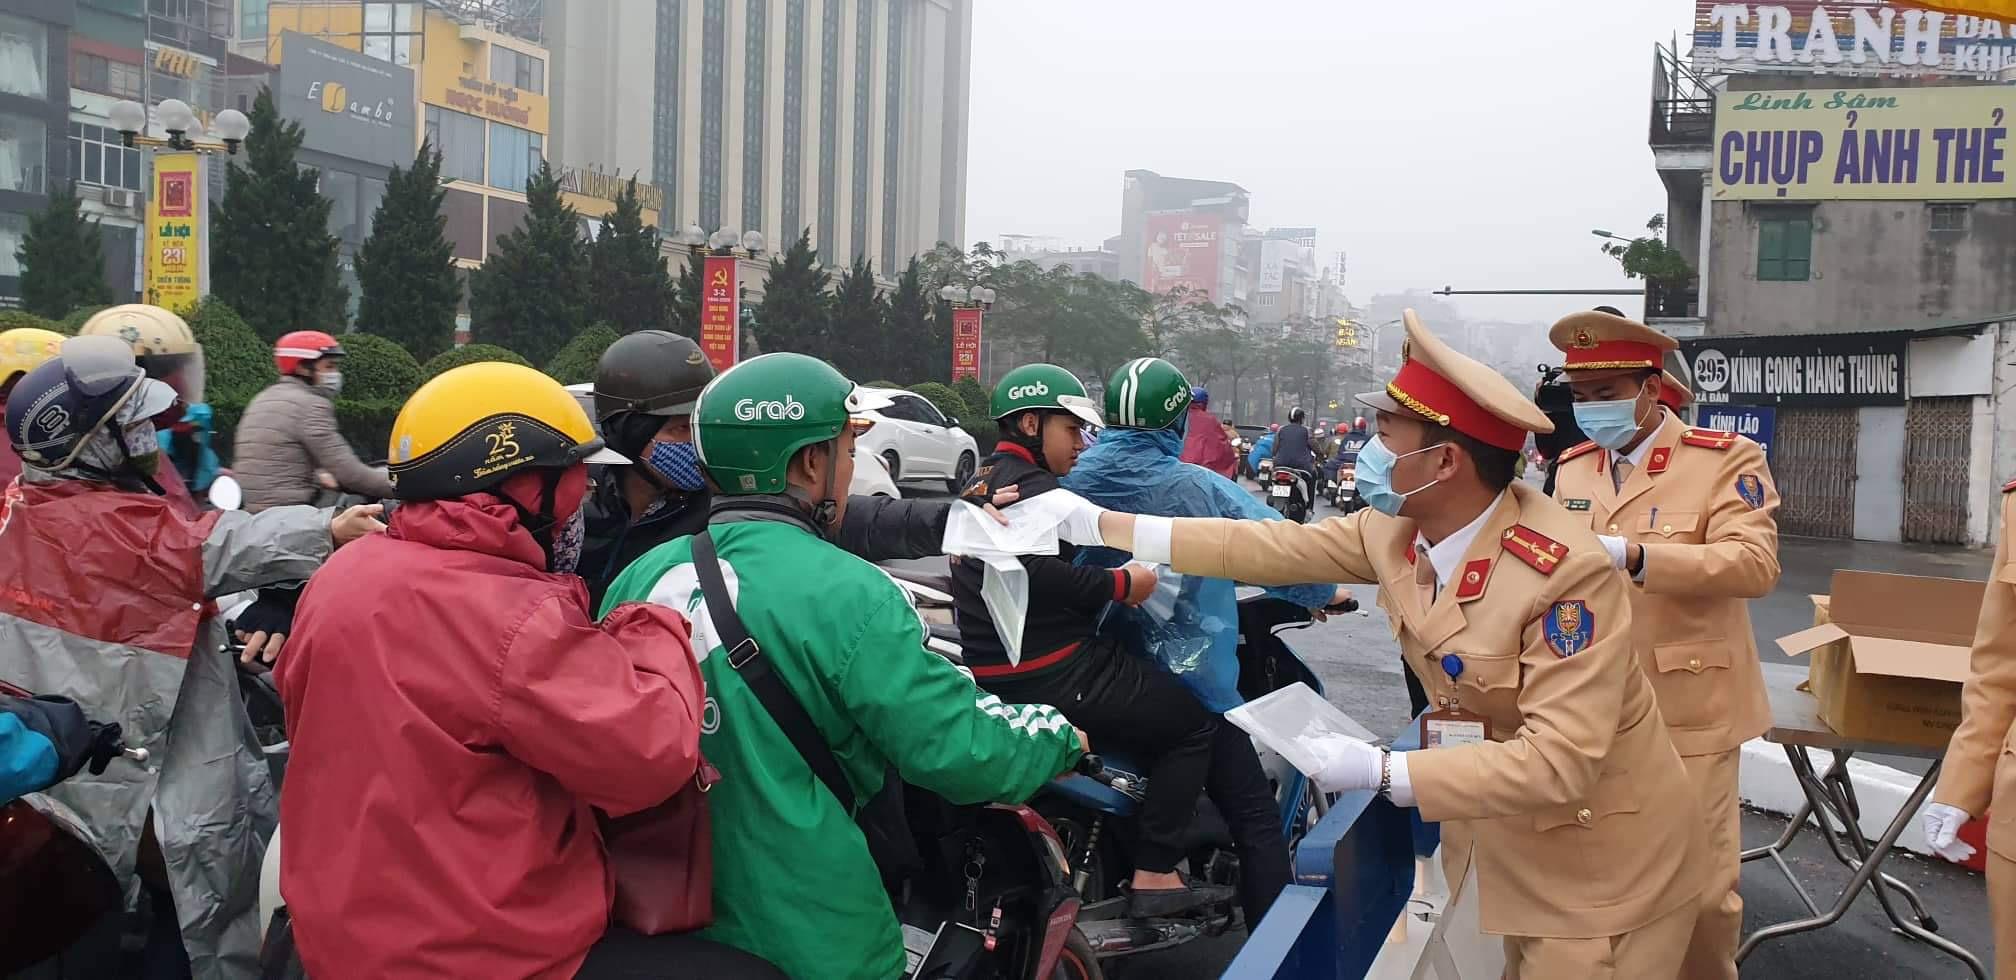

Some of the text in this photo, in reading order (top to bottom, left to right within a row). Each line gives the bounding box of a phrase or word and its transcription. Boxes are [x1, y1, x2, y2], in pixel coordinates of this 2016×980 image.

[1711, 4, 1946, 66] TRANH
[1733, 91, 1900, 111] Linh Sâm
[1719, 107, 2007, 197] CHỤP ẢNH THẺ
[162, 247, 186, 266] 231
[1697, 358, 1727, 383] 295
[1730, 349, 1762, 393] KÍNH
[1765, 356, 1802, 402] GỌNG
[1805, 347, 1845, 394] HÀNG
[1008, 380, 1049, 400] Grab
[1164, 384, 1188, 412] Grab
[735, 394, 805, 421] Grab
[1709, 411, 1759, 435] KÍNH LÃO
[485, 433, 520, 458] 25
